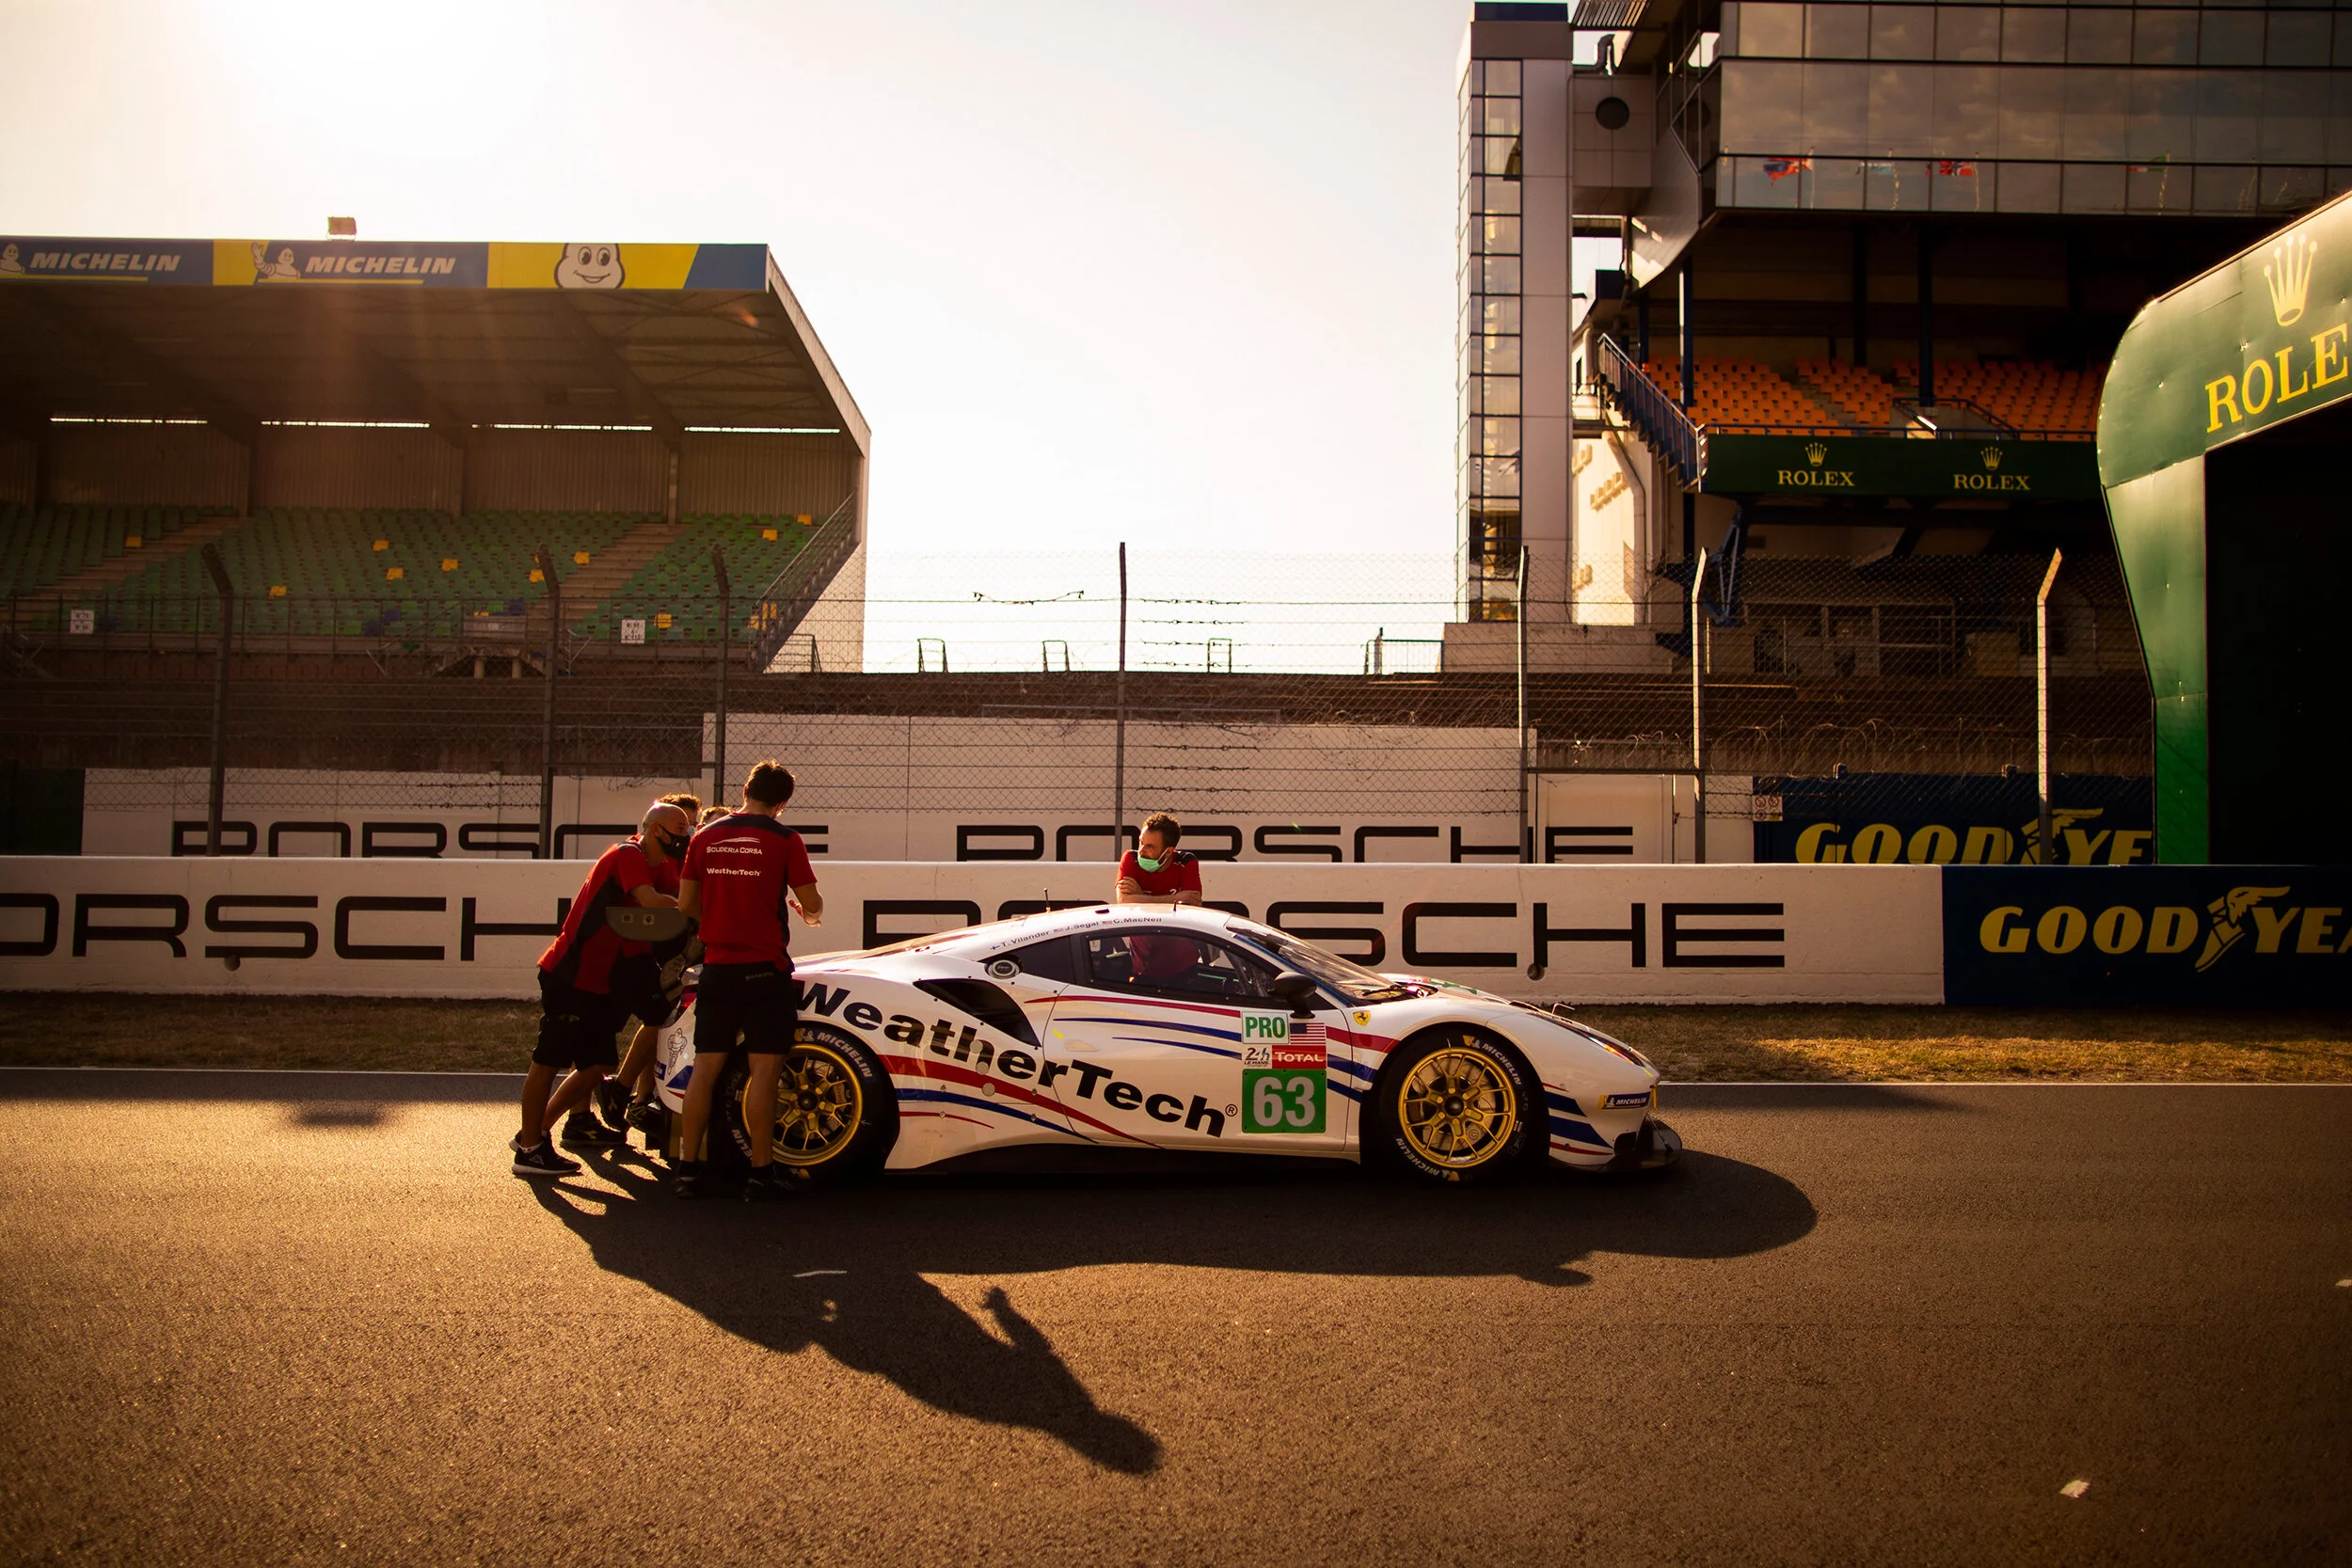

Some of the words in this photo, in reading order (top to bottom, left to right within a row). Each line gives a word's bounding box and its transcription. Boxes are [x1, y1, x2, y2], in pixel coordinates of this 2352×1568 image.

[29, 253, 181, 272] MICHELIN
[305, 256, 456, 275] MICHELIN
[2204, 323, 2349, 434] ROLE
[1776, 469, 1855, 487] ROLEX
[1953, 473, 2031, 491] ROLEX
[706, 846, 739, 854] SCUDERIA
[739, 847, 763, 855] CORSA
[863, 899, 1785, 968] PSCHE
[1245, 1016, 1286, 1038] PRO
[817, 1032, 873, 1078] MICHELIN
[1275, 1052, 1324, 1063] TOTAL
[1482, 1042, 1522, 1085] MICHELIN
[1253, 1076, 1315, 1127] 63
[1615, 1097, 1646, 1105] MICHELIN
[1395, 1137, 1439, 1176] MICHELIN
